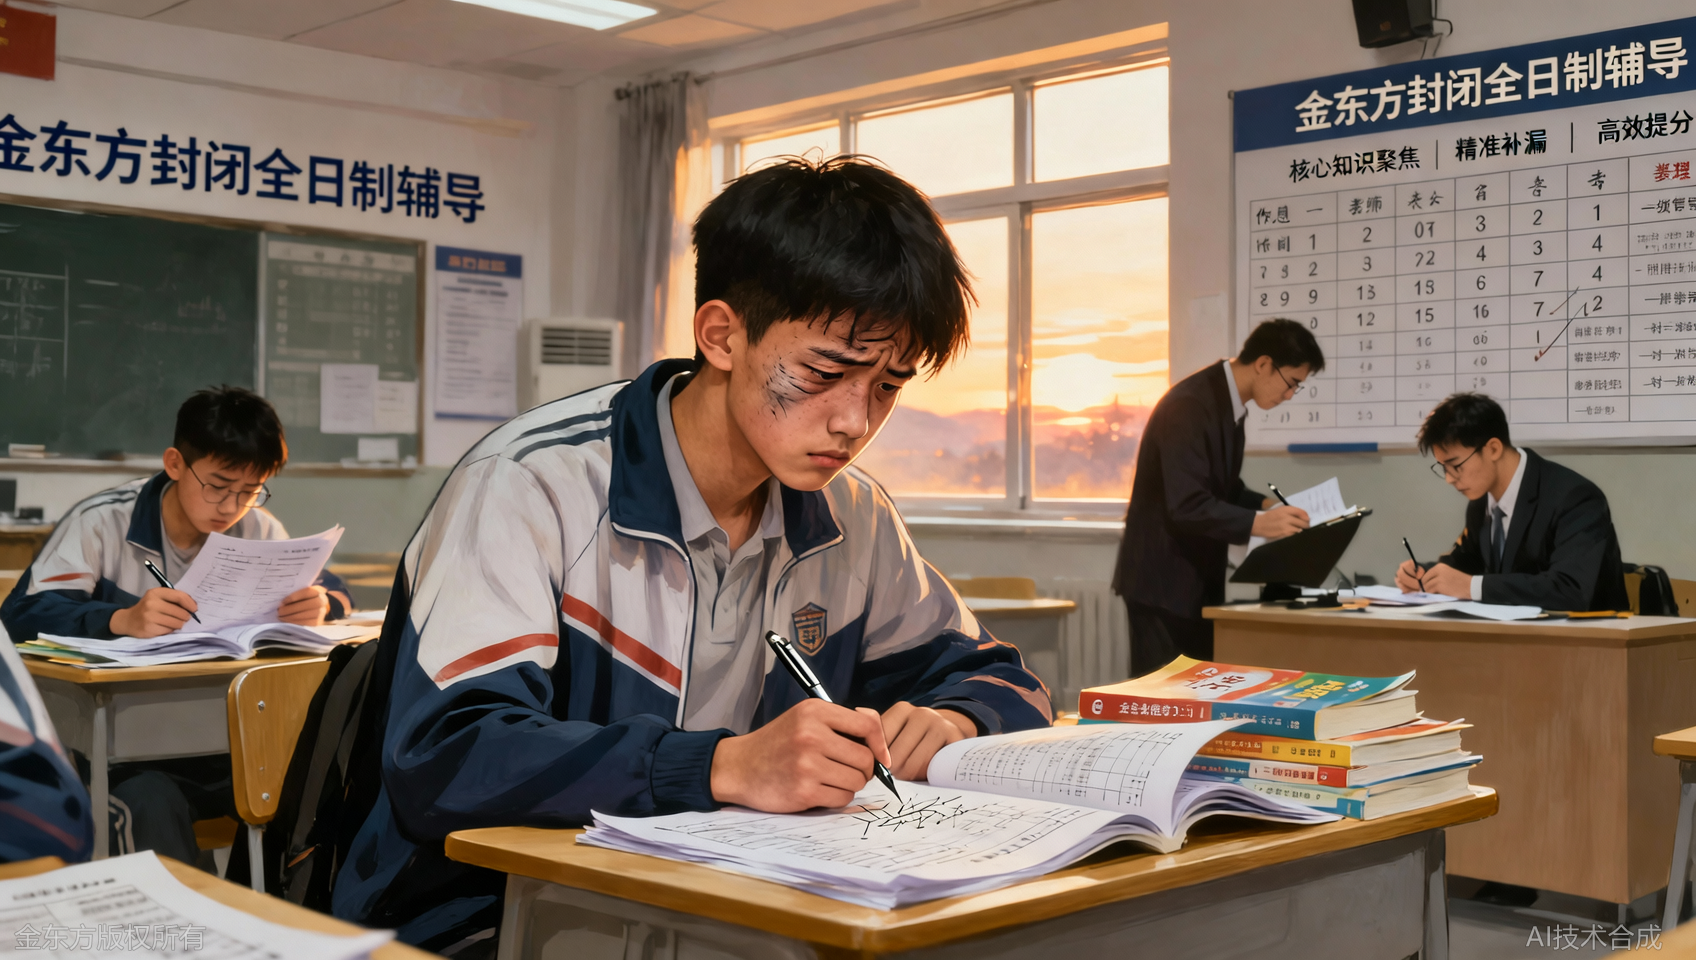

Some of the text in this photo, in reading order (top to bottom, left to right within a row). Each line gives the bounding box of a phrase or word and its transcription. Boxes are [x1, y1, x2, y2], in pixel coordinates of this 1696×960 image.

[1294, 36, 1688, 133] 金东方封闭全日制辅导
[1288, 110, 1695, 183] 核心知识聚焦 精准补漏 高效提分
[0, 114, 486, 224] 金东方封闭全日制辅导
[1362, 226, 1372, 243] 2
[1475, 215, 1486, 232] 3
[1532, 209, 1543, 226] 2
[1593, 204, 1600, 221] 1
[1308, 261, 1318, 277] 2
[1362, 256, 1372, 272] 3
[1476, 245, 1487, 262] 4
[1533, 240, 1543, 256] 3
[1591, 234, 1603, 252] 4
[1280, 290, 1290, 307] 9
[1308, 289, 1318, 305] 9
[1476, 275, 1486, 291] 6
[1533, 270, 1544, 287] 7
[1591, 265, 1602, 282] 4
[1357, 311, 1376, 327] 12
[1415, 307, 1435, 324] 15
[1472, 304, 1489, 319] 16
[1533, 301, 1544, 317] 7
